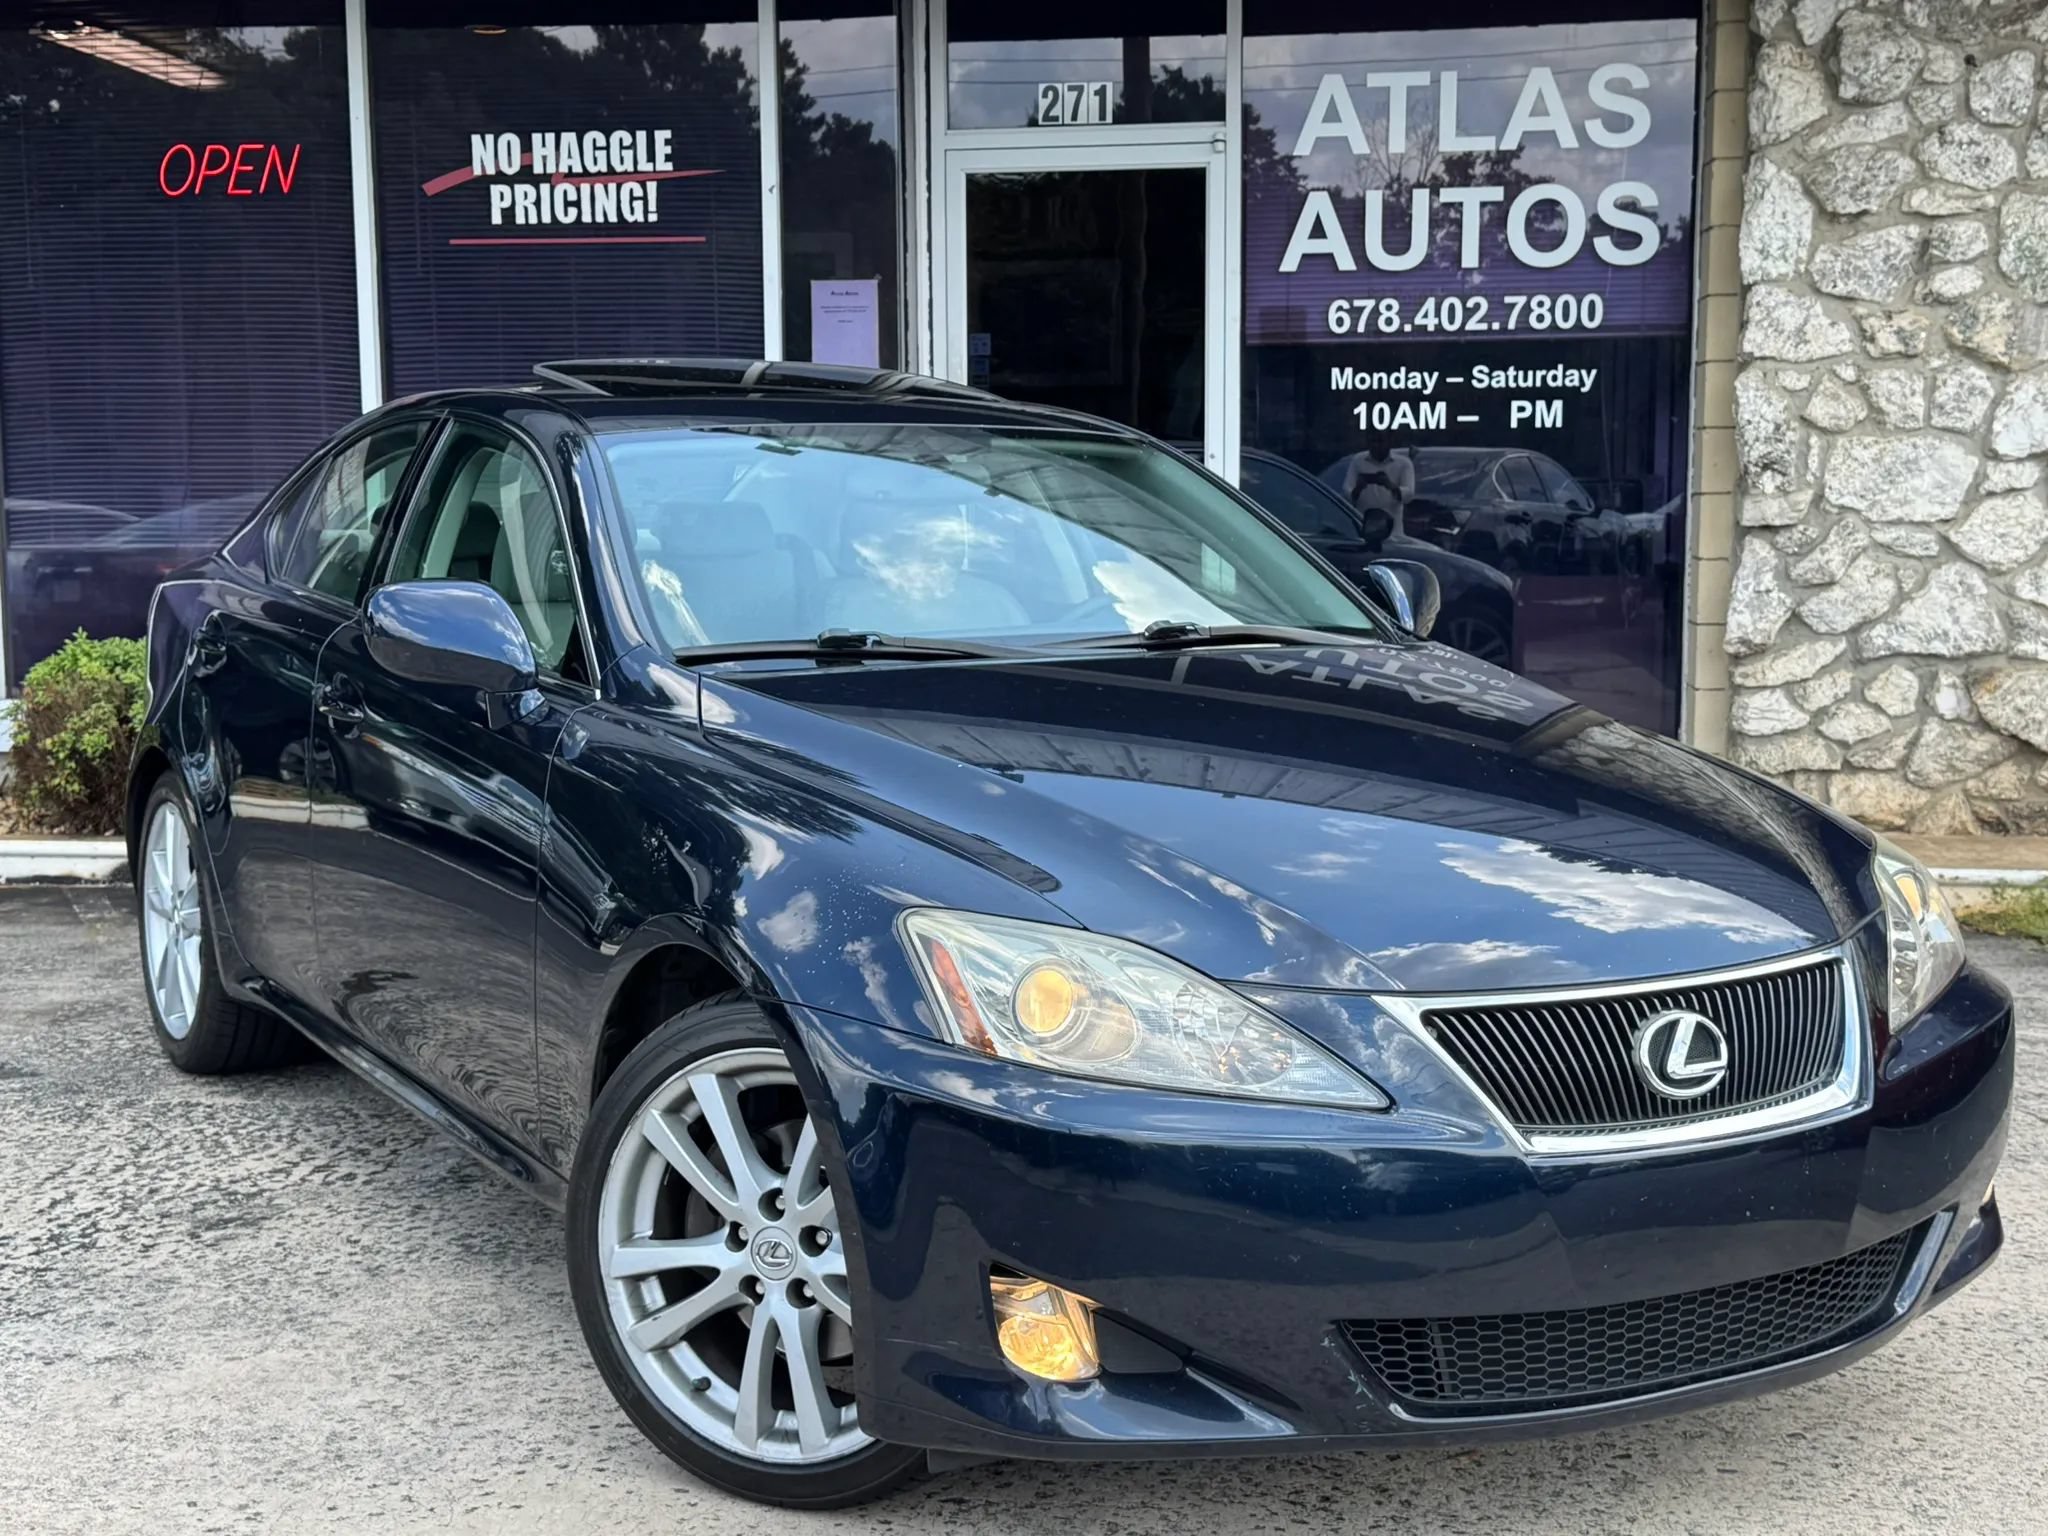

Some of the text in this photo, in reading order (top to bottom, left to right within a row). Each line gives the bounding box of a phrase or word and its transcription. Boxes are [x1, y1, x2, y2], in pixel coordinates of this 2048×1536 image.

[1041, 84, 1109, 123] 271
[1293, 63, 1651, 156] ATLAS
[159, 143, 300, 197] OPEN
[471, 130, 673, 176] NO HAGGLE
[490, 182, 658, 225] PRICING!
[1279, 181, 1661, 273] AUTOS
[1327, 293, 1604, 334] 678.402.7800
[1331, 366, 1439, 395] Monday
[1471, 363, 1598, 393] Saturday
[1353, 401, 1447, 430] 10AM
[1510, 399, 1563, 429] PM
